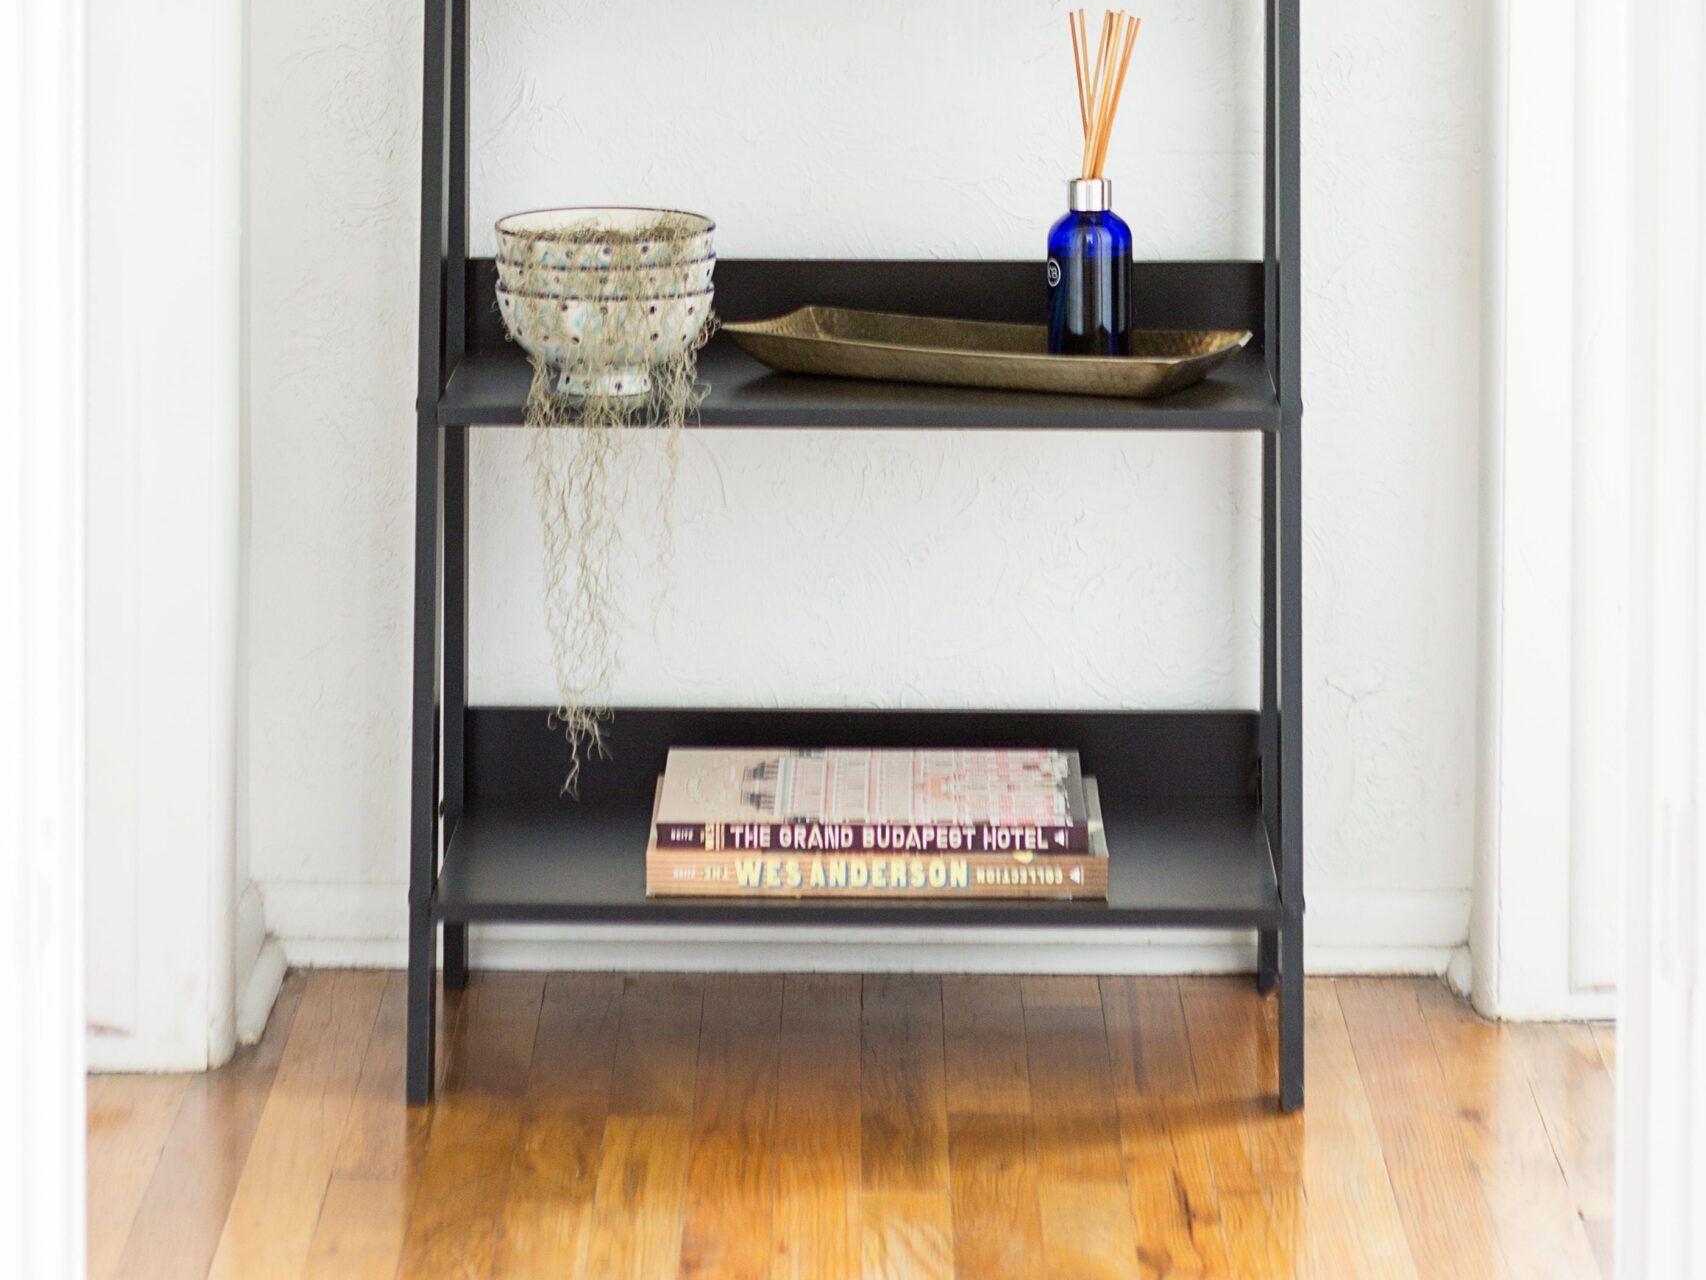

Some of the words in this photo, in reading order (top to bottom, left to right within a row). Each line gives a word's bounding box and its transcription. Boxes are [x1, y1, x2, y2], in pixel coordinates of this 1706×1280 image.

[730, 824, 771, 849] THE
[779, 824, 853, 850] GRAND
[862, 824, 976, 850] BUDAPEST
[983, 824, 1049, 850] HOTEL
[735, 858, 804, 888] WES
[810, 858, 970, 888] ANDERSON
[976, 866, 1063, 884] COLLECTION
